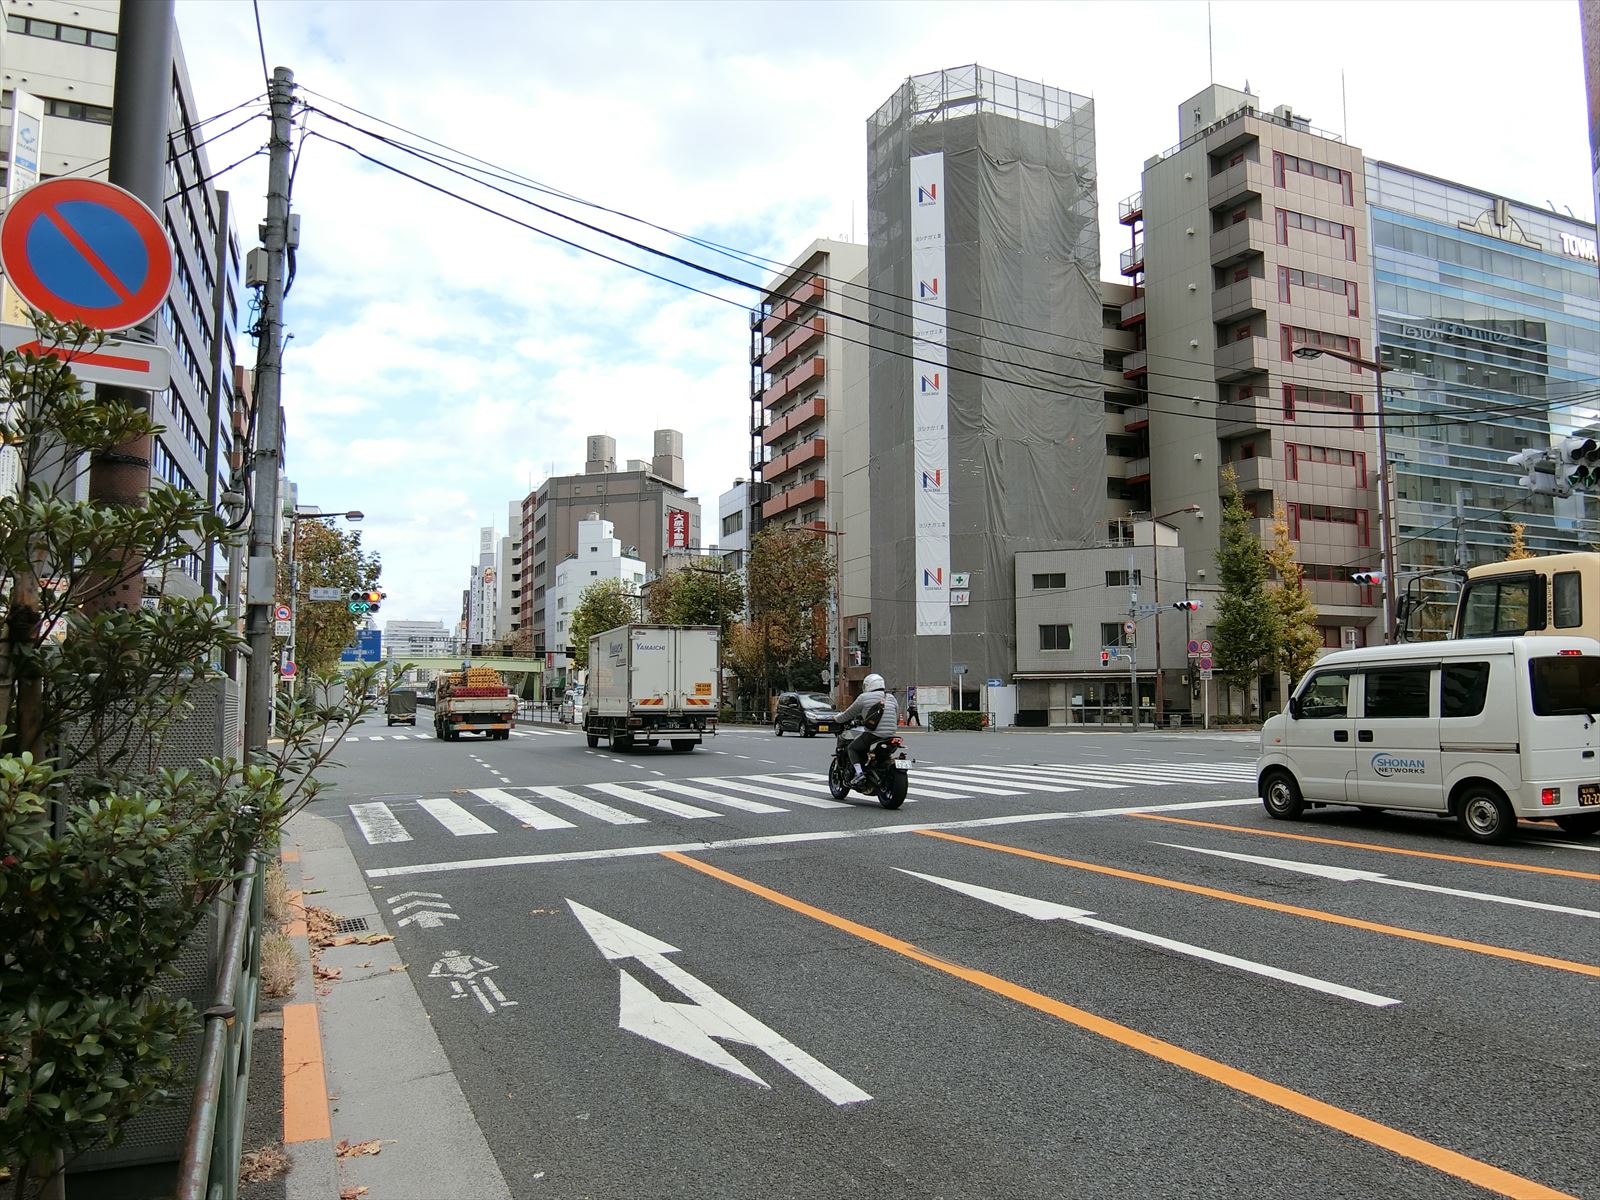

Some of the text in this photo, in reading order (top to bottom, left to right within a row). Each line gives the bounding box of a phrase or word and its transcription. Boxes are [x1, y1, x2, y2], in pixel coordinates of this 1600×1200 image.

[1561, 233, 1598, 261] TOWA
[636, 642, 666, 651] YAMAICHI
[1377, 758, 1425, 768] SHONAN
